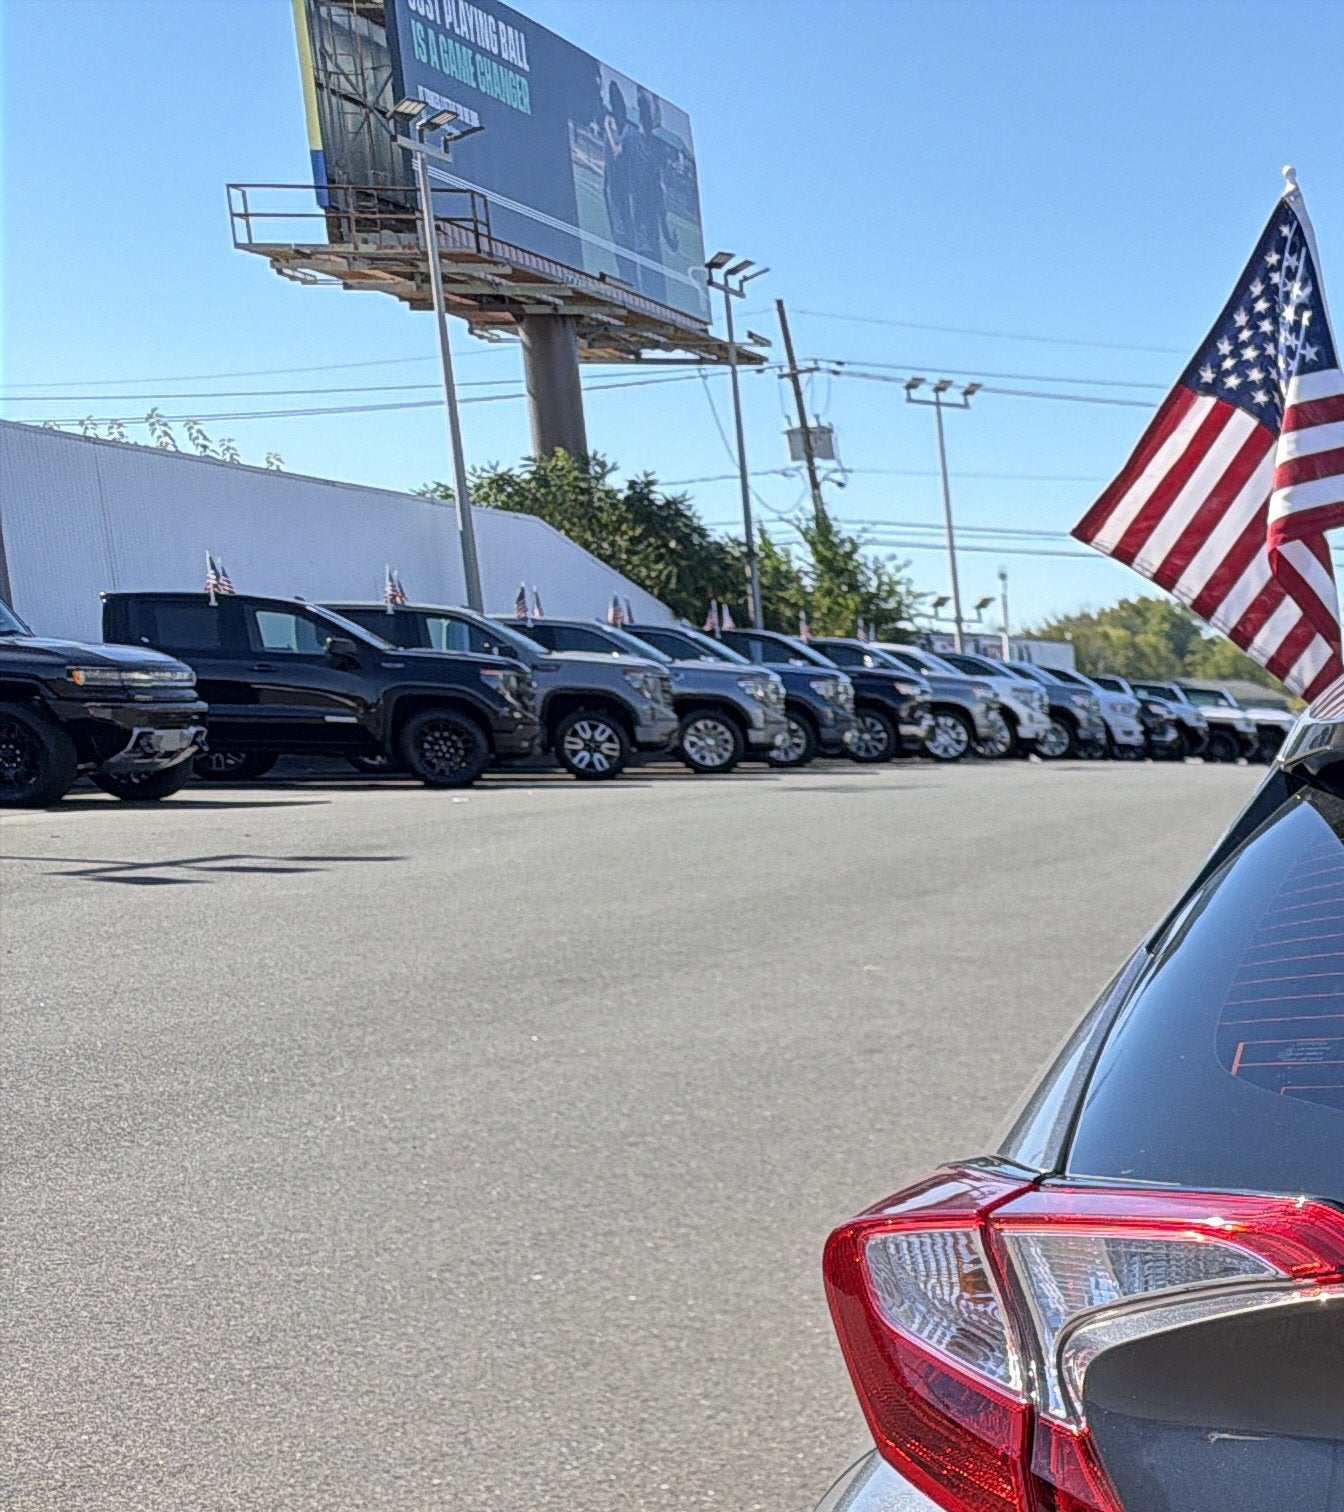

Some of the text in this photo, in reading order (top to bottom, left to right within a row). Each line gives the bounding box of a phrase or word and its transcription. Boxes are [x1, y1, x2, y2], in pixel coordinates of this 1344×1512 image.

[408, 0, 530, 72] ST PLAYING BALL
[411, 18, 427, 64] IS
[427, 27, 440, 71] A
[439, 33, 477, 89] GAME
[475, 52, 532, 116] CHANGER
